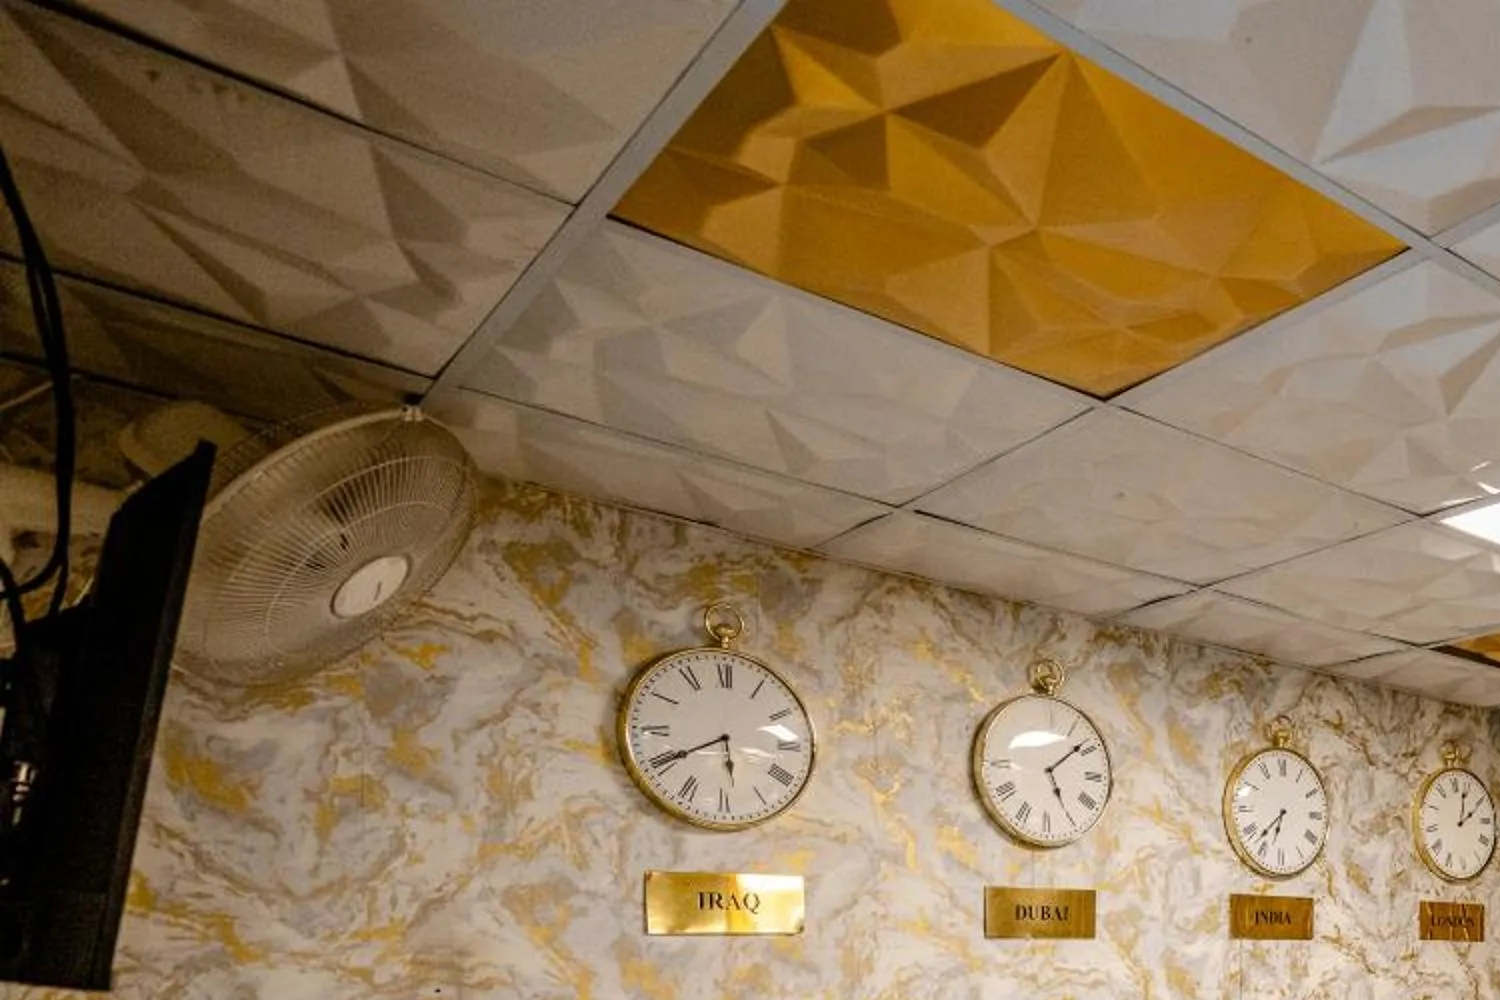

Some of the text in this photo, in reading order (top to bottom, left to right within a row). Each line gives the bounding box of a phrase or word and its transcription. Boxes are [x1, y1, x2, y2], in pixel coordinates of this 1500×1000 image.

[698, 891, 760, 915] IRAQ
[1015, 904, 1069, 921] DUBAI
[1255, 911, 1292, 925] INDIA
